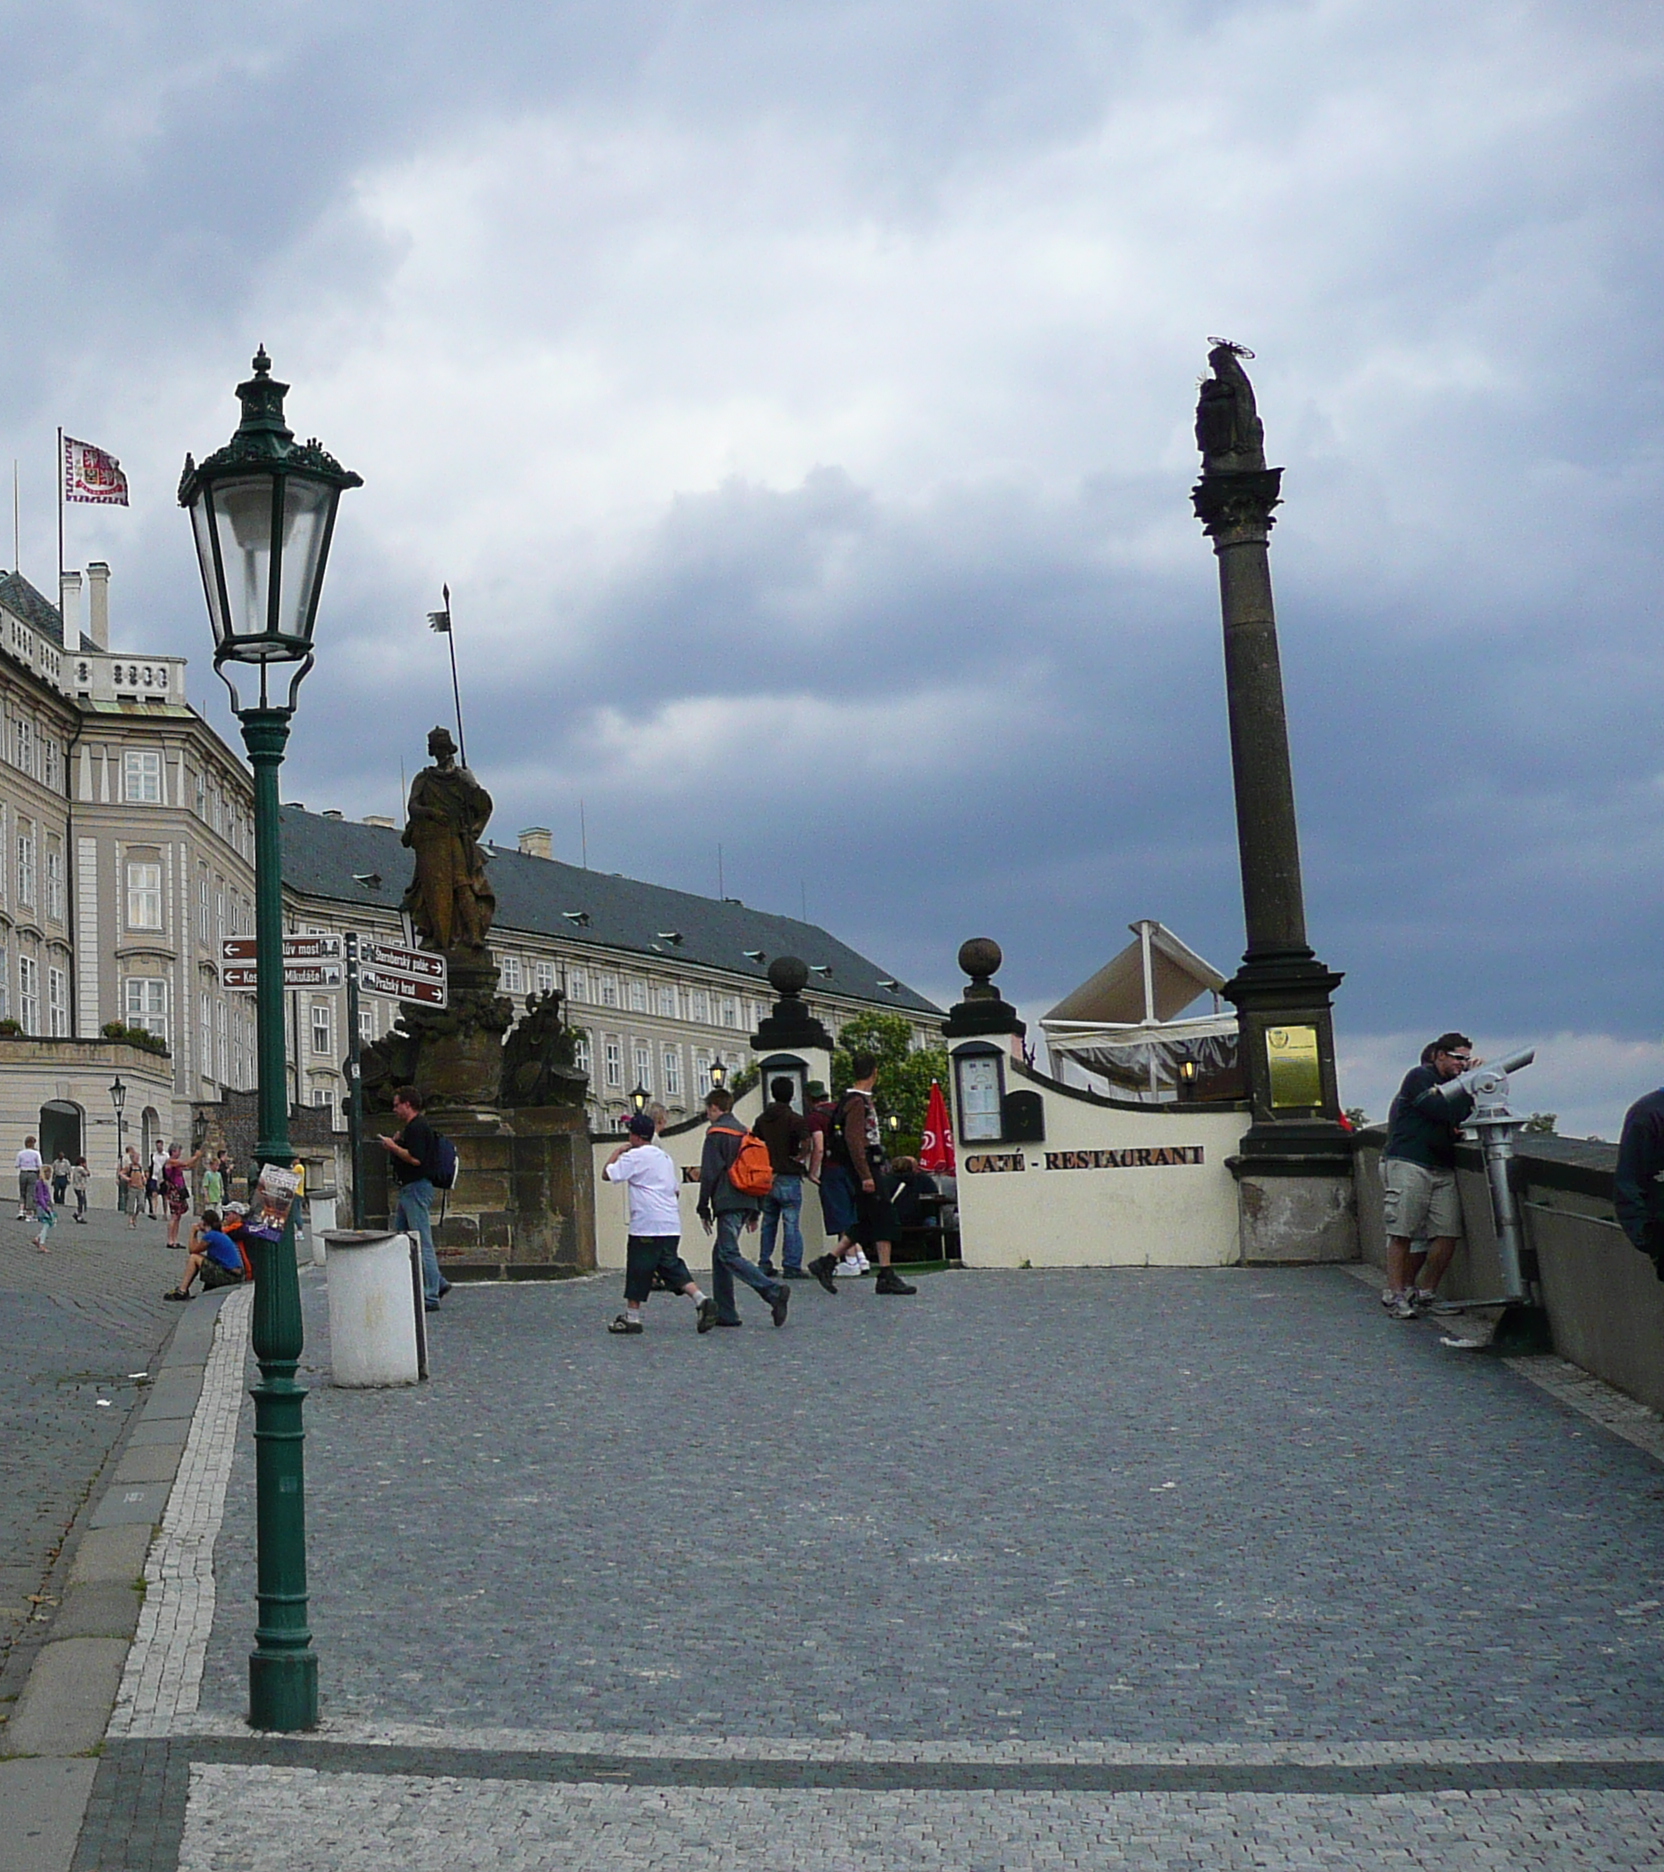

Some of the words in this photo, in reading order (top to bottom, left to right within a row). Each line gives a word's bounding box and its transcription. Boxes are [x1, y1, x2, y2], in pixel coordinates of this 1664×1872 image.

[298, 942, 320, 955] most
[243, 969, 257, 983] Kos
[284, 969, 320, 983] Mikuláše
[401, 980, 416, 996] hrad
[965, 1148, 1025, 1174] CAFÉ
[1044, 1146, 1204, 1170] RESTAURANT
